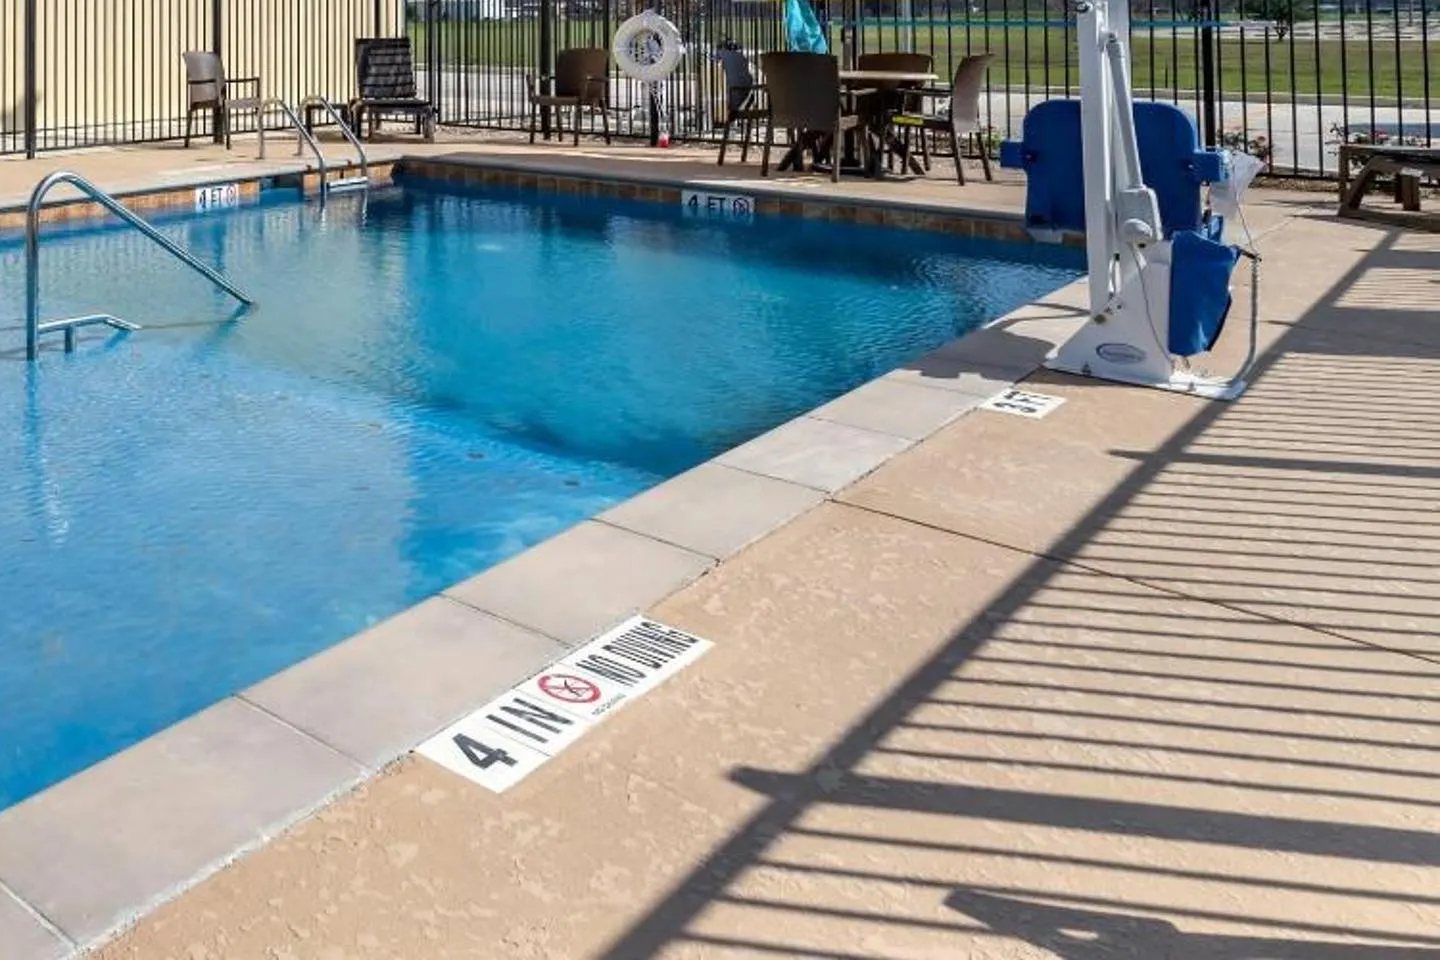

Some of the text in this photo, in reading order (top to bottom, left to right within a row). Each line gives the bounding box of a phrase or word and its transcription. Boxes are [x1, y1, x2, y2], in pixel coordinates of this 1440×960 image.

[602, 620, 700, 670] DIVING
[575, 653, 647, 688] NO
[486, 697, 575, 744] IN
[451, 733, 518, 769] 4
